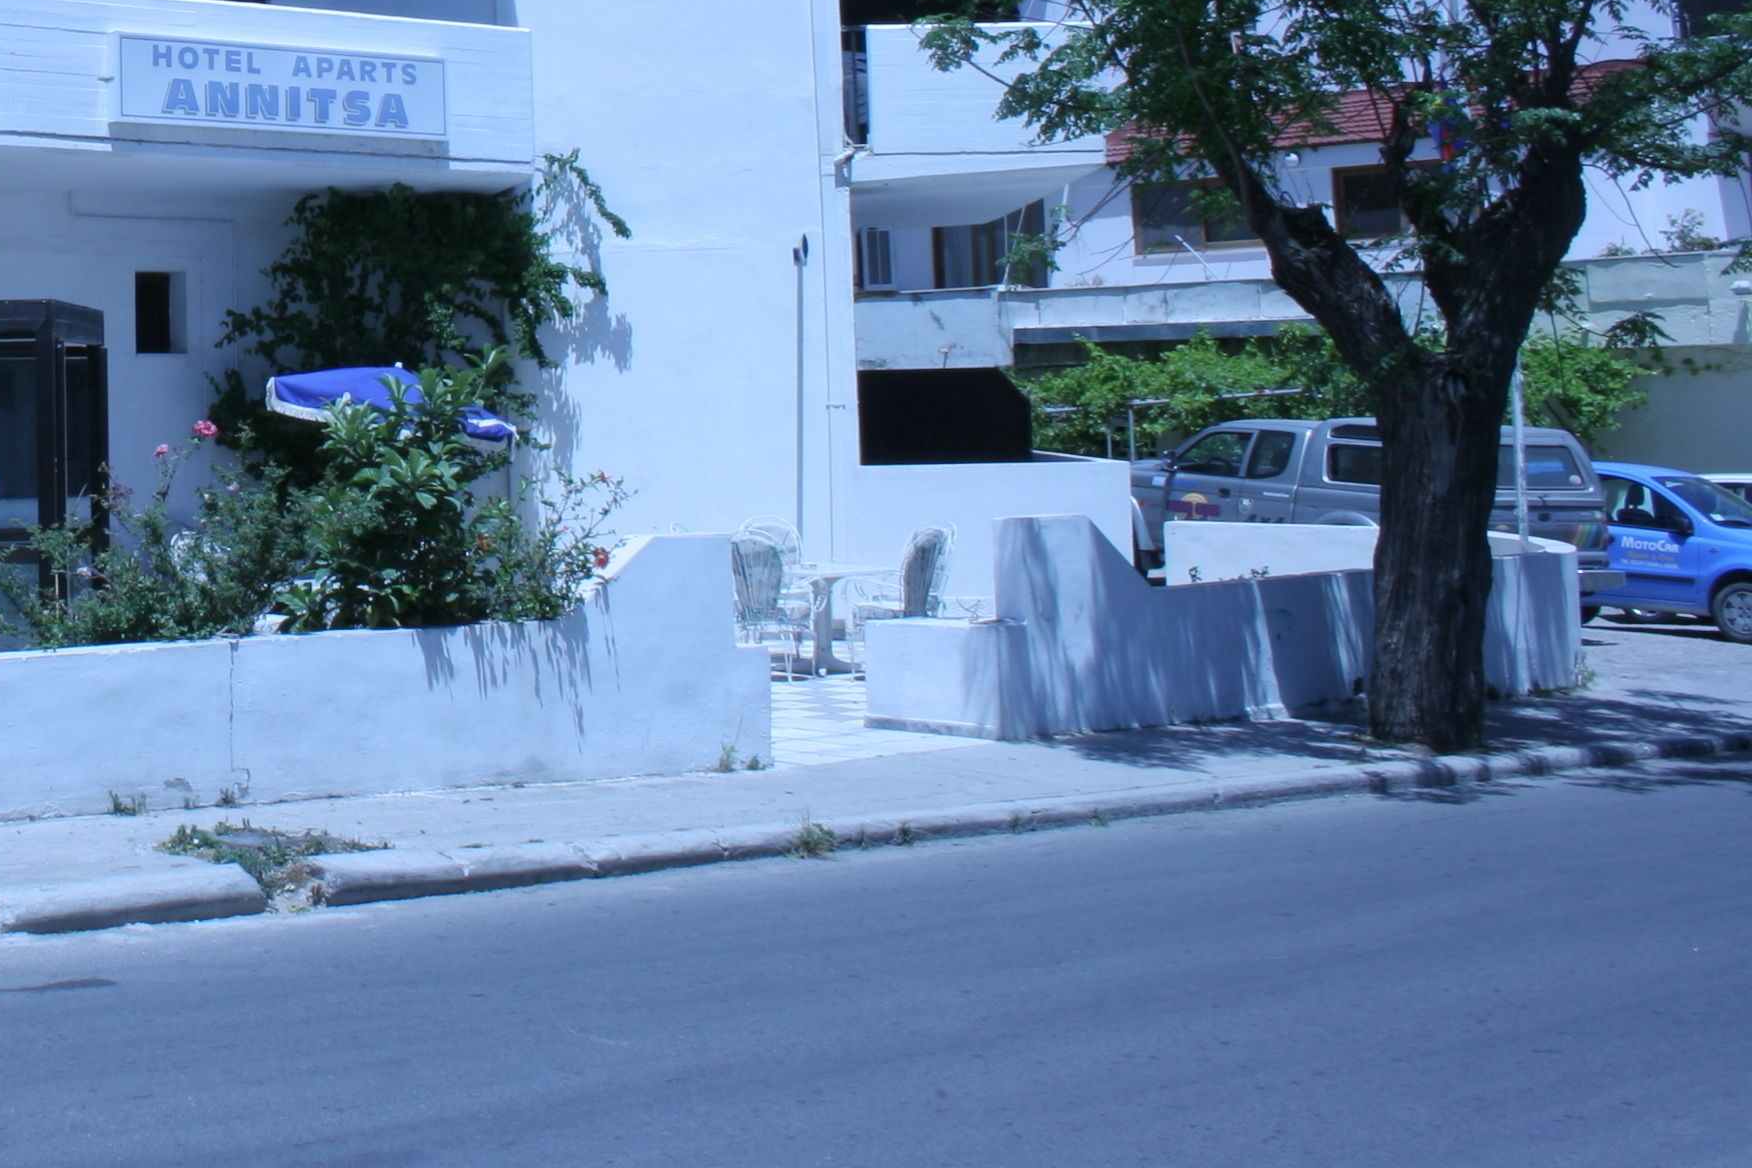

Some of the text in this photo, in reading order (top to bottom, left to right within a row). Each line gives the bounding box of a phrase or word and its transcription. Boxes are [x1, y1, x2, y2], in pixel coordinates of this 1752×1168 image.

[153, 44, 417, 86] HOTEL APARTS
[161, 78, 409, 128] ANNITSA
